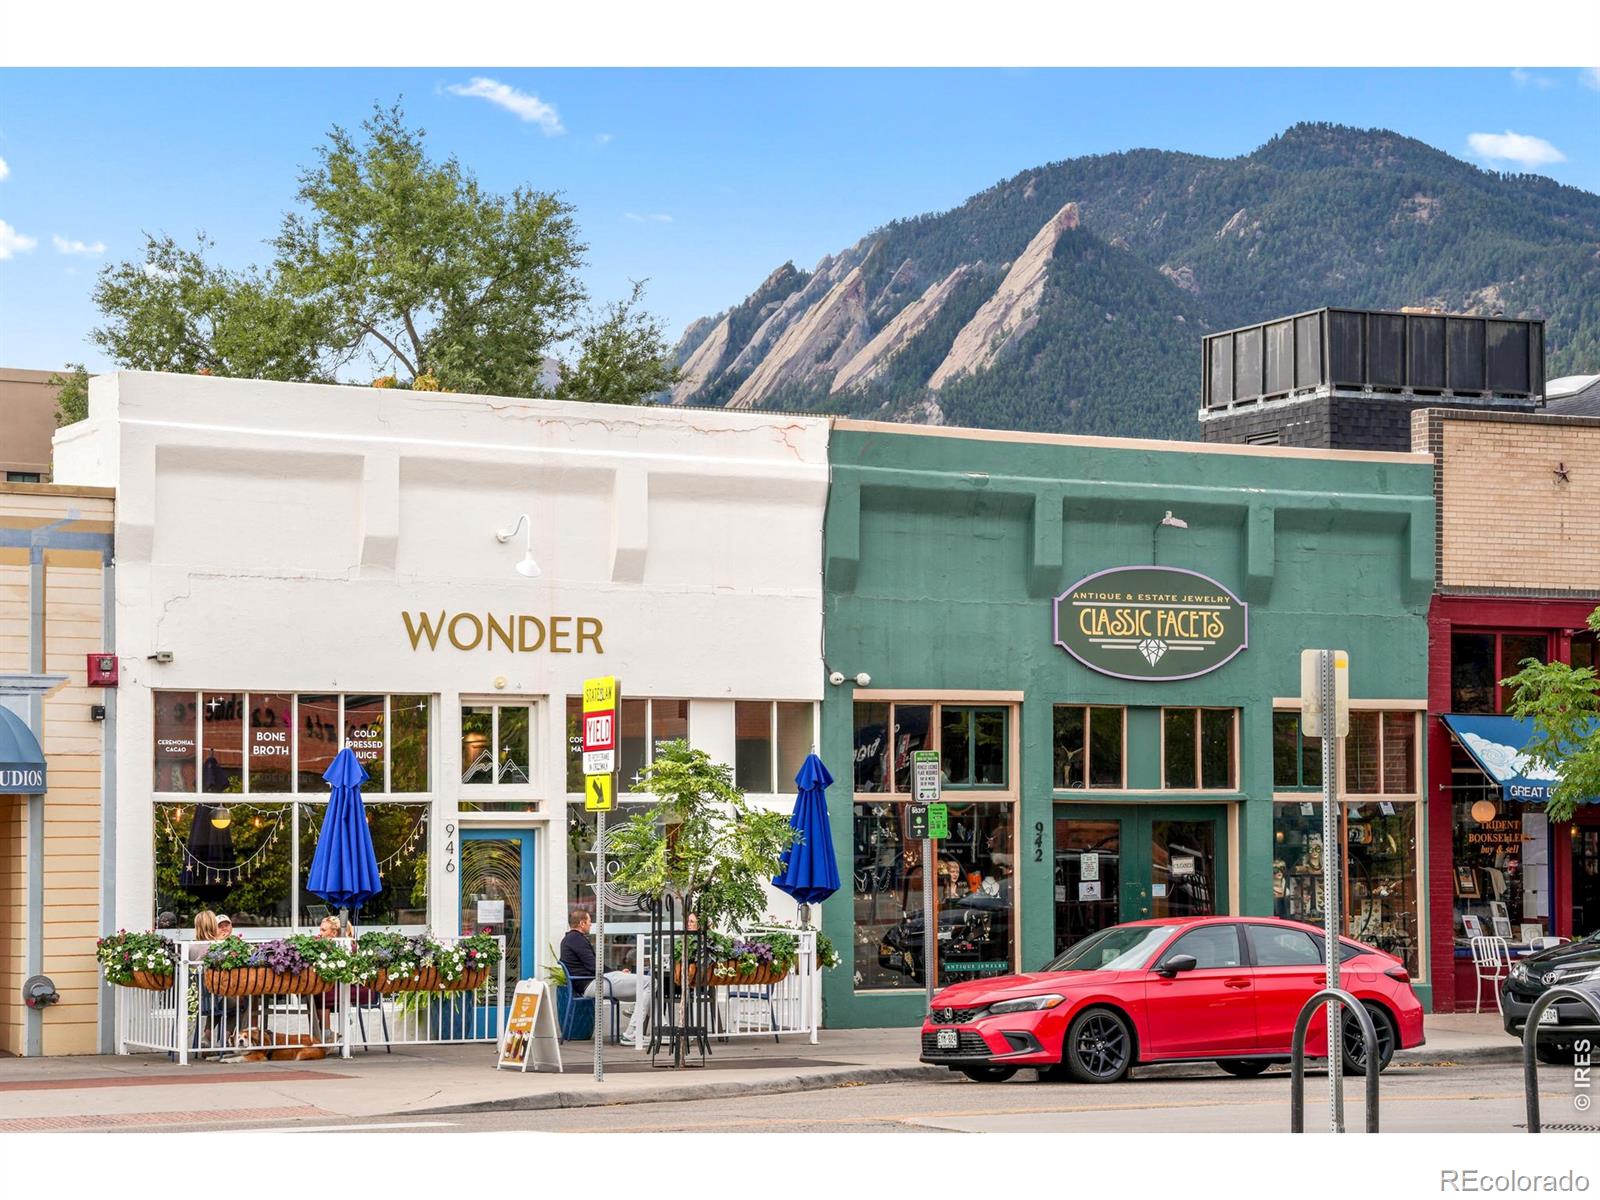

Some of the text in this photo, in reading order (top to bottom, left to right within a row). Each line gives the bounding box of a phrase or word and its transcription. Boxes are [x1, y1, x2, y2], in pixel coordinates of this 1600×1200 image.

[1072, 592, 1121, 600] ANTIQUE
[1137, 593, 1178, 602] ESTATE
[1182, 594, 1231, 604] JEWELRY
[1079, 608, 1225, 639] CLASSIC FACETS
[401, 609, 604, 654] WONDER
[256, 731, 286, 742] BONE
[353, 730, 377, 738] COLD
[587, 718, 610, 743] YIELD
[253, 745, 289, 756] BROTH
[349, 740, 383, 749] PRESSED
[355, 751, 378, 759] JUICE
[0, 770, 42, 787] UDIOS
[1510, 785, 1544, 798] GREAT
[1480, 820, 1520, 830] TRIDENT
[445, 823, 455, 873] 946
[1034, 821, 1044, 863] 942
[1481, 844, 1520, 856] buy & sell
